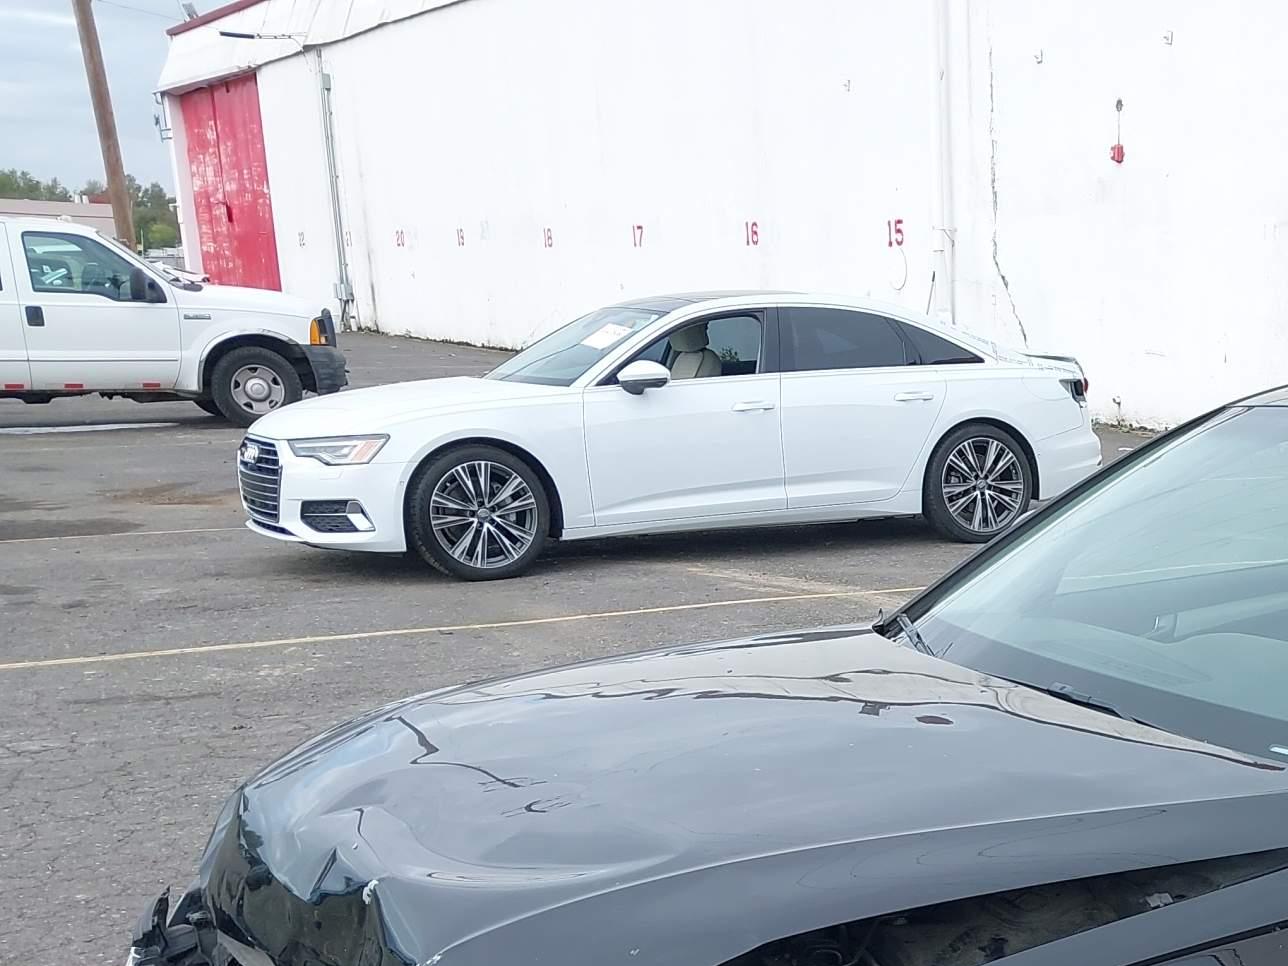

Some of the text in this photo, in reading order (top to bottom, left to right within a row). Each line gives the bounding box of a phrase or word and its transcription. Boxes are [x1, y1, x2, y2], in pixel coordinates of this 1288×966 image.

[395, 229, 405, 247] 20
[456, 228, 465, 247] 19
[543, 228, 553, 248] 18
[632, 224, 644, 248] 17
[745, 221, 759, 247] 16
[887, 219, 904, 248] 15
